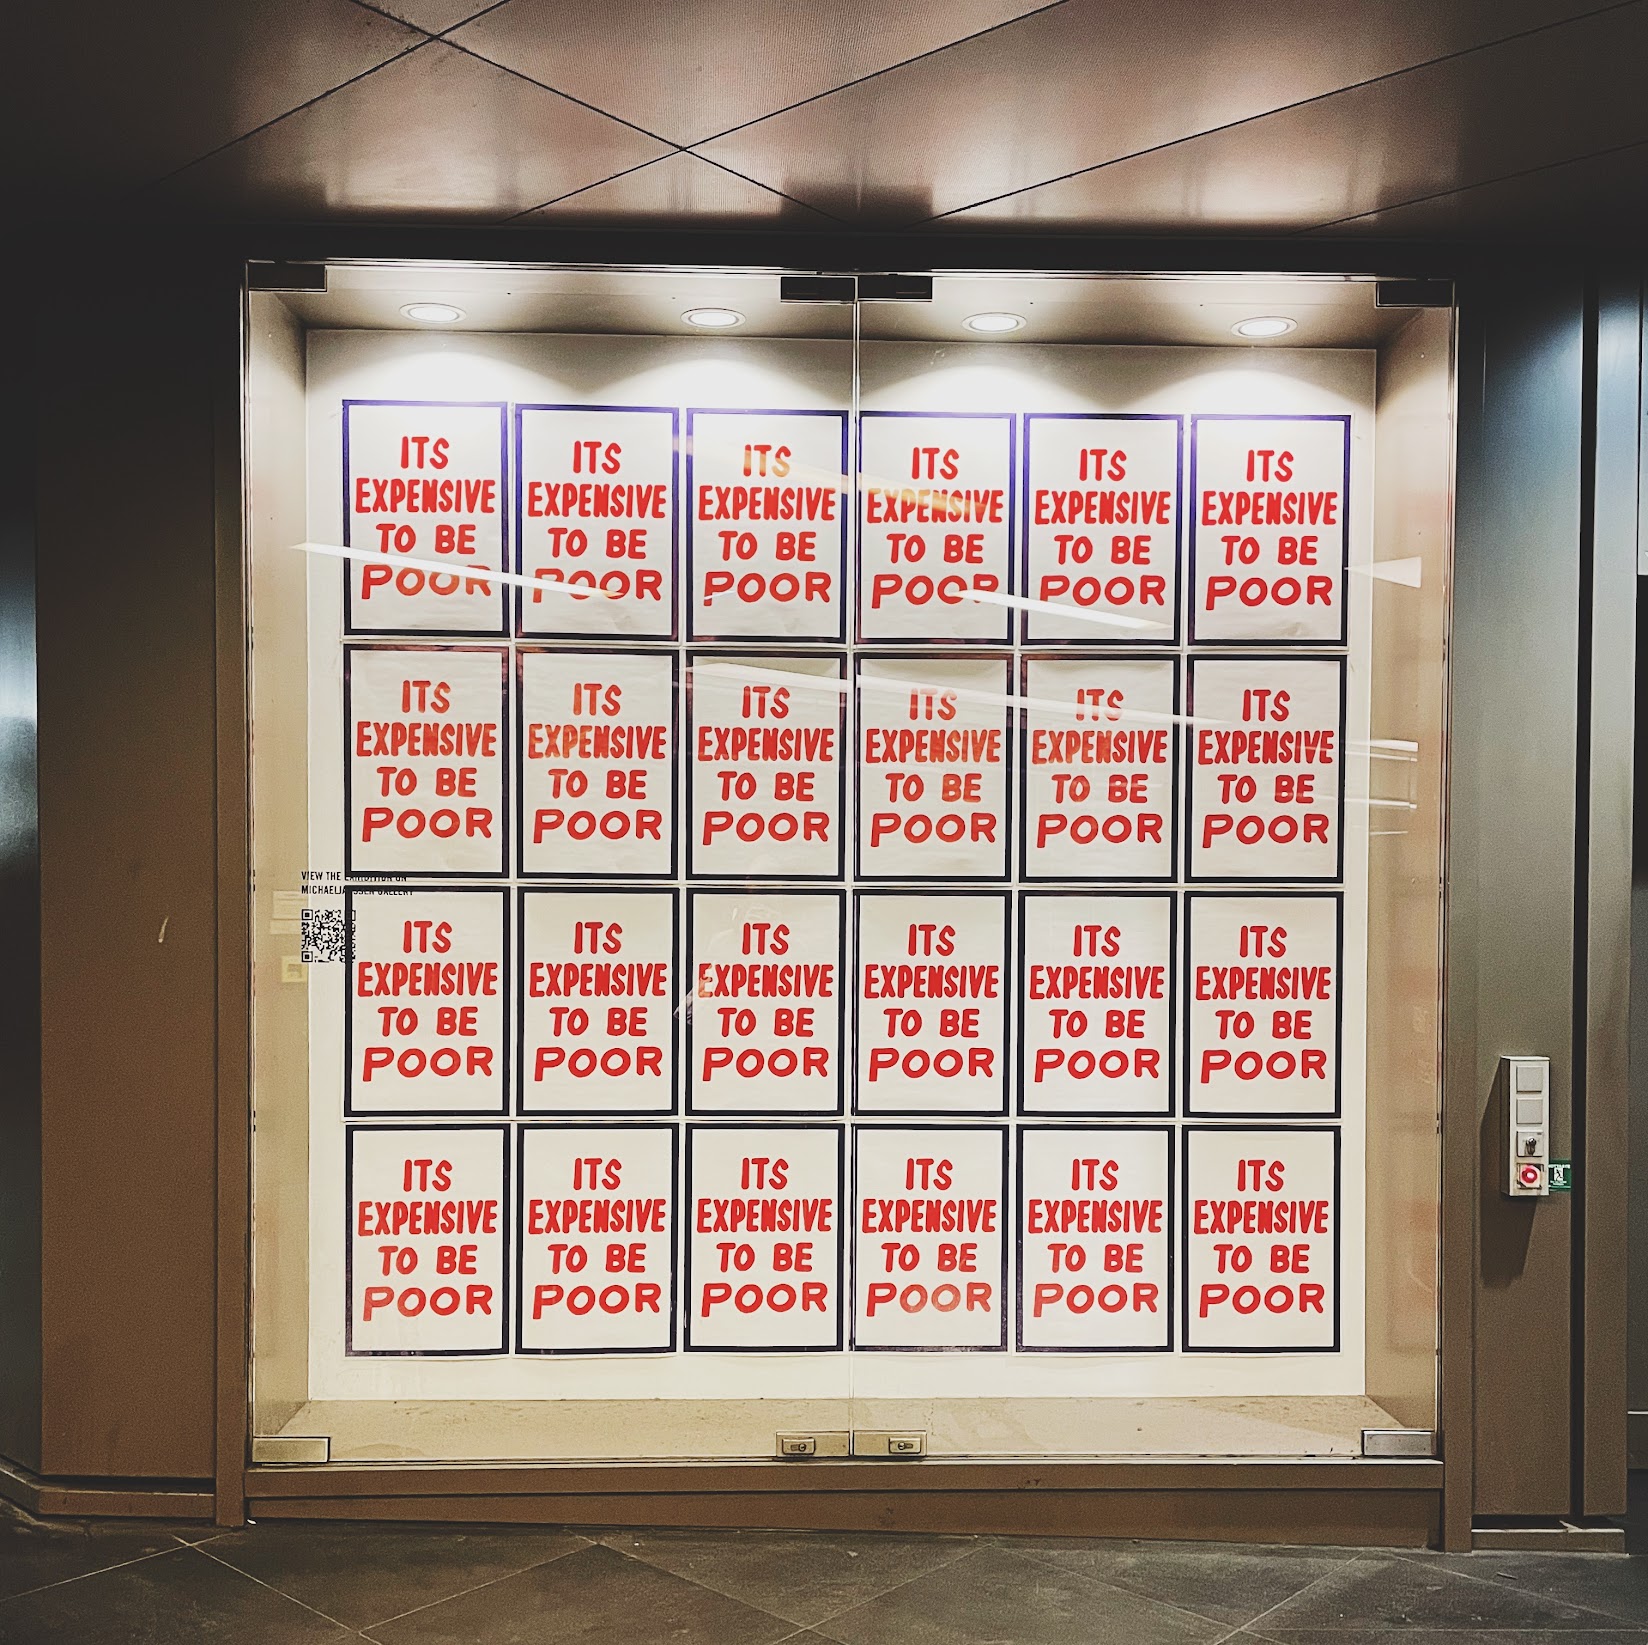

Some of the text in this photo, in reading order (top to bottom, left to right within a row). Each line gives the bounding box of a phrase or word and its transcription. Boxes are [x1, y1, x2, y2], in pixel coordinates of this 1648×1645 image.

[400, 436, 449, 469] ITS
[573, 440, 621, 474] ITS
[743, 444, 790, 476] ITS
[911, 447, 959, 479] ITS
[1079, 448, 1126, 481] ITS
[1246, 449, 1293, 482] ITS
[355, 477, 495, 513] EXPENSIVE
[528, 481, 666, 518] EXPENSIVE
[698, 485, 835, 520] EXPENSIVE
[866, 489, 1003, 523] EXPENSIVE
[1034, 489, 1170, 525] EXPENSIVE
[1201, 490, 1337, 525] EXPENSIVE
[375, 523, 476, 554] TO BE
[547, 527, 646, 559] TO BE
[718, 530, 815, 561] TO BE
[886, 533, 984, 563] TO BE
[1053, 534, 1151, 565] TO BE
[1221, 535, 1318, 565] TO BE
[361, 564, 491, 599] POOR
[703, 571, 831, 606] POOR
[1039, 574, 1165, 607] POOR
[1205, 575, 1332, 610] POOR
[402, 680, 450, 713] ITS
[573, 683, 621, 716] ITS
[742, 685, 789, 718] ITS
[909, 687, 956, 720] ITS
[1076, 688, 1123, 721] ITS
[1242, 689, 1290, 721] ITS
[356, 721, 495, 756] EXPENSIVE
[528, 723, 666, 759] EXPENSIVE
[697, 725, 834, 761] EXPENSIVE
[865, 728, 1000, 763] EXPENSIVE
[1031, 729, 1167, 764] EXPENSIVE
[1197, 729, 1333, 765] EXPENSIVE
[376, 766, 476, 797] TO BE
[548, 768, 647, 800] TO BE
[717, 770, 814, 801] TO BE
[885, 772, 981, 802] TO BE
[1051, 773, 1147, 803] TO BE
[1217, 773, 1314, 803] TO BE
[362, 807, 492, 842] POOR
[533, 809, 662, 843] POOR
[702, 810, 829, 845] POOR
[870, 812, 996, 847] POOR
[1036, 813, 1162, 848] POOR
[1202, 813, 1328, 848] POOR
[301, 871, 323, 880] VIEW
[326, 871, 341, 880] THE
[402, 920, 451, 953] ITS
[573, 921, 622, 954] ITS
[741, 922, 789, 955] ITS
[907, 923, 955, 956] ITS
[1073, 924, 1120, 957] ITS
[1239, 925, 1286, 957] ITS
[357, 961, 497, 997] EXPENSIVE
[529, 961, 667, 997] EXPENSIVE
[698, 962, 833, 998] EXPENSIVE
[864, 963, 998, 998] EXPENSIVE
[1029, 964, 1164, 999] EXPENSIVE
[1195, 965, 1330, 1000] EXPENSIVE
[377, 1006, 478, 1036] TO BE
[548, 1006, 647, 1036] TO BE
[717, 1007, 814, 1037] TO BE
[883, 1007, 979, 1038] TO BE
[1048, 1008, 1145, 1038] TO BE
[1215, 1009, 1311, 1039] TO BE
[362, 1045, 493, 1081] POOR
[534, 1045, 662, 1081] POOR
[702, 1046, 828, 1081] POOR
[868, 1047, 994, 1081] POOR
[1034, 1048, 1159, 1082] POOR
[1200, 1049, 1326, 1084] POOR
[403, 1159, 452, 1192] ITS
[573, 1157, 621, 1190] ITS
[741, 1157, 788, 1189] ITS
[905, 1158, 952, 1190] ITS
[1071, 1158, 1118, 1190] ITS
[1237, 1159, 1284, 1191] ITS
[357, 1200, 497, 1236] EXPENSIVE
[528, 1198, 666, 1234] EXPENSIVE
[696, 1197, 832, 1233] EXPENSIVE
[861, 1198, 996, 1233] EXPENSIVE
[1028, 1199, 1162, 1233] EXPENSIVE
[1193, 1199, 1328, 1234] EXPENSIVE
[378, 1244, 477, 1275] TO BE
[547, 1242, 646, 1274] TO BE
[716, 1241, 812, 1272] TO BE
[881, 1242, 977, 1272] TO BE
[1047, 1243, 1143, 1272] TO BE
[1213, 1243, 1309, 1273] TO BE
[363, 1284, 492, 1321] POOR
[532, 1282, 661, 1319] POOR
[701, 1281, 827, 1317] POOR
[866, 1282, 991, 1316] POOR
[1033, 1282, 1158, 1317] POOR
[1199, 1283, 1324, 1318] POOR
